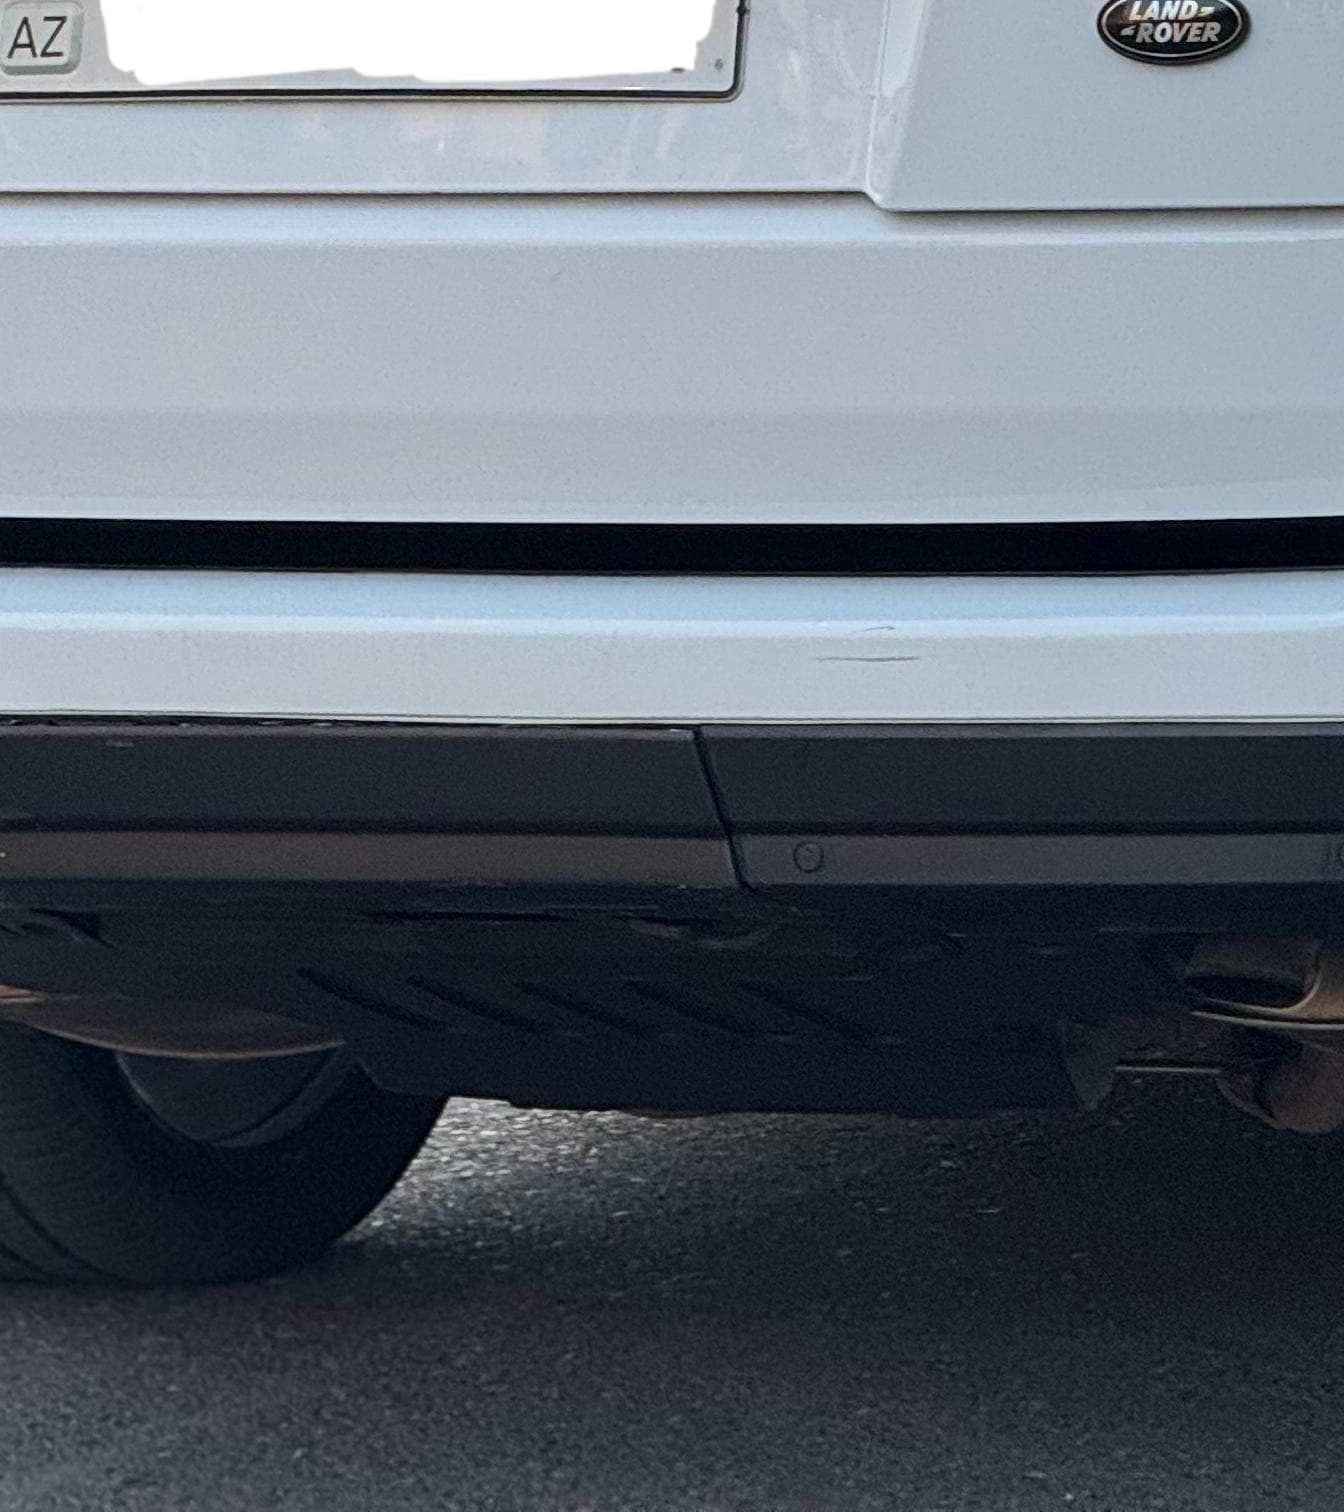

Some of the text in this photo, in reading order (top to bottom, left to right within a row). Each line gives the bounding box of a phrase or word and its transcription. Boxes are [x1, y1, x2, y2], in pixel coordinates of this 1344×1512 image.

[1128, 0, 1200, 21] LAND
[6, 15, 68, 59] AZ
[1135, 21, 1222, 44] ROVER
